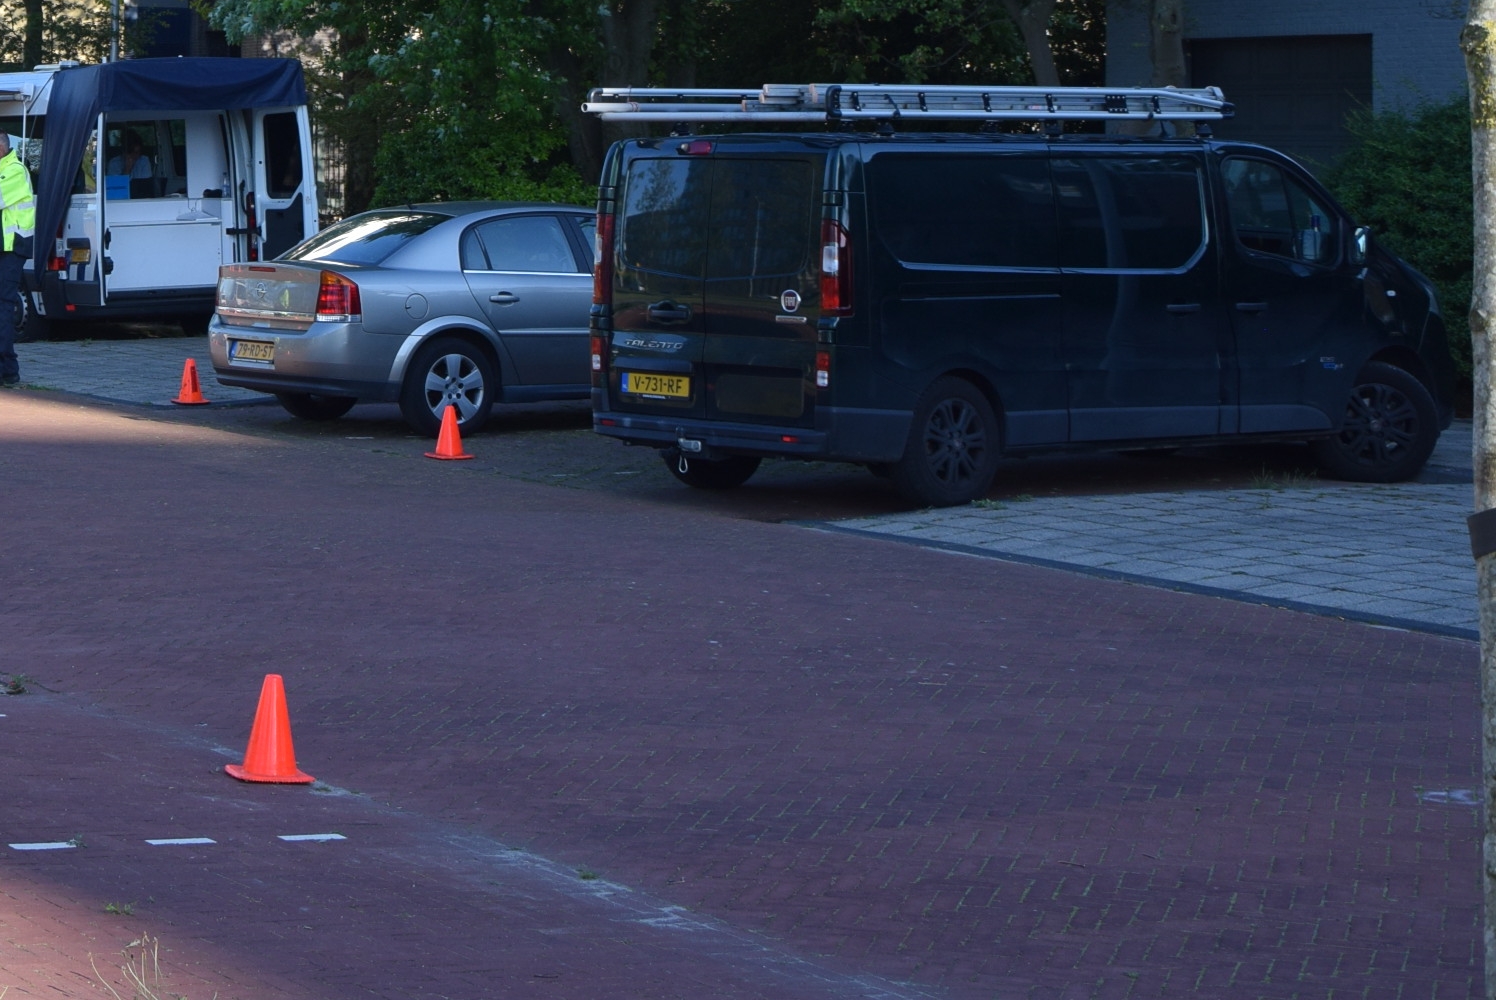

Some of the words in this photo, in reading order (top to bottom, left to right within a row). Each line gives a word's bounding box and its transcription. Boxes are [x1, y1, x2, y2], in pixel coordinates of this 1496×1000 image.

[237, 342, 274, 358] 79-RD-ST
[625, 339, 684, 350] TALENTO
[633, 375, 683, 394] V-731-RF
